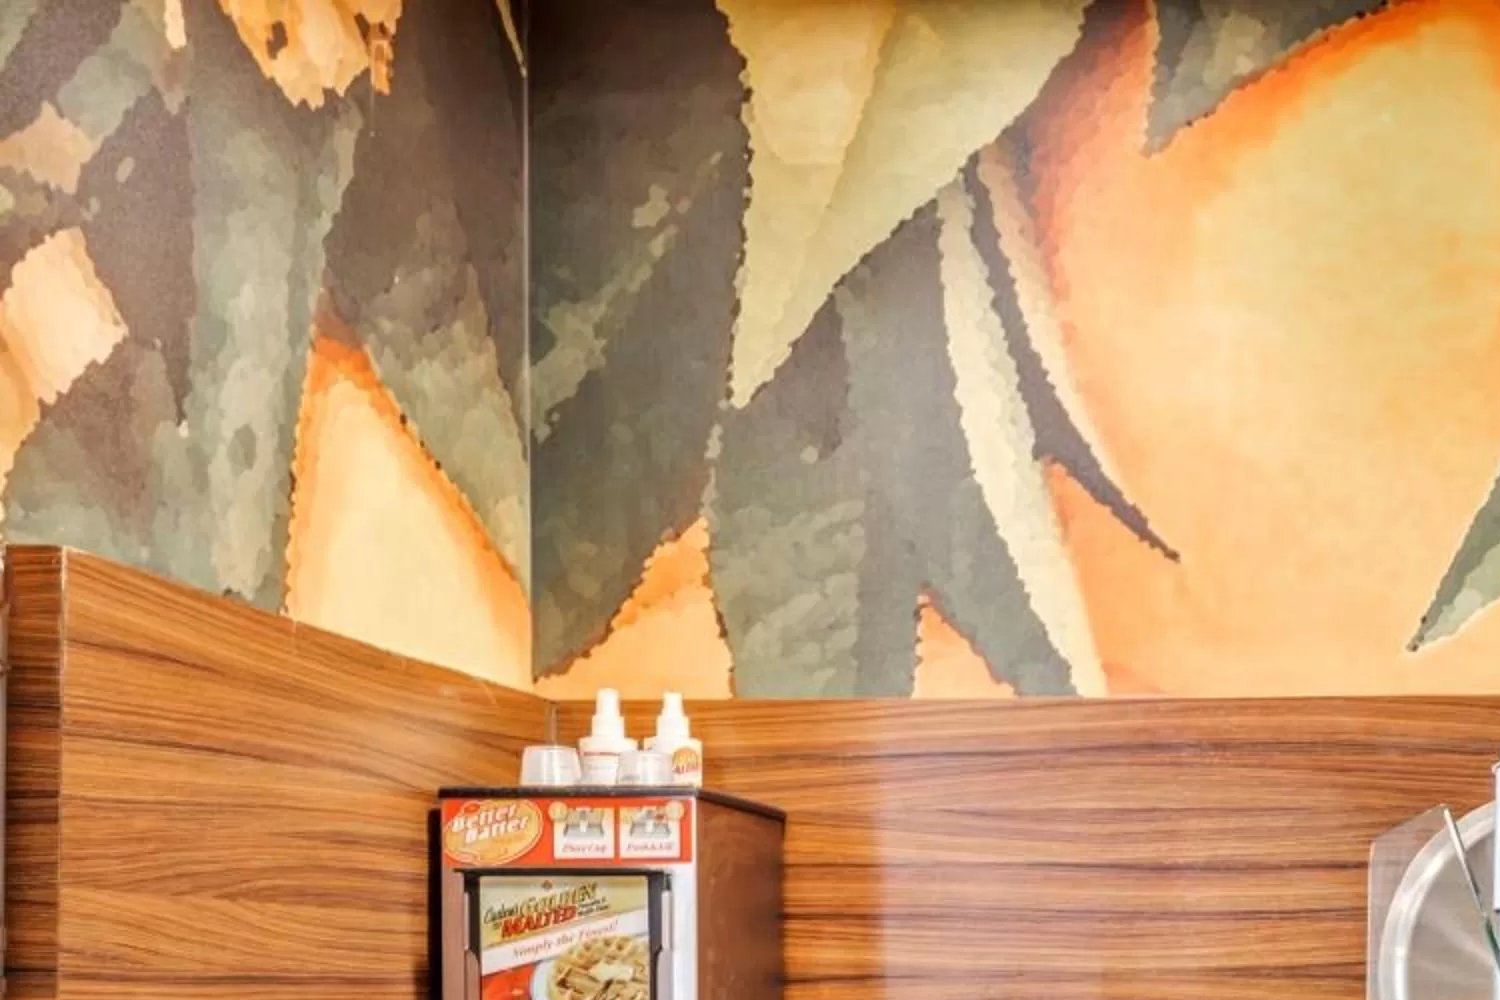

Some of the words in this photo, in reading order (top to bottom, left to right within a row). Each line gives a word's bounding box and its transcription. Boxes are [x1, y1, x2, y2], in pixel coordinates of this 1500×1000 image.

[452, 804, 517, 832] Better
[465, 816, 529, 843] Batter
[501, 905, 578, 939] MALTED
